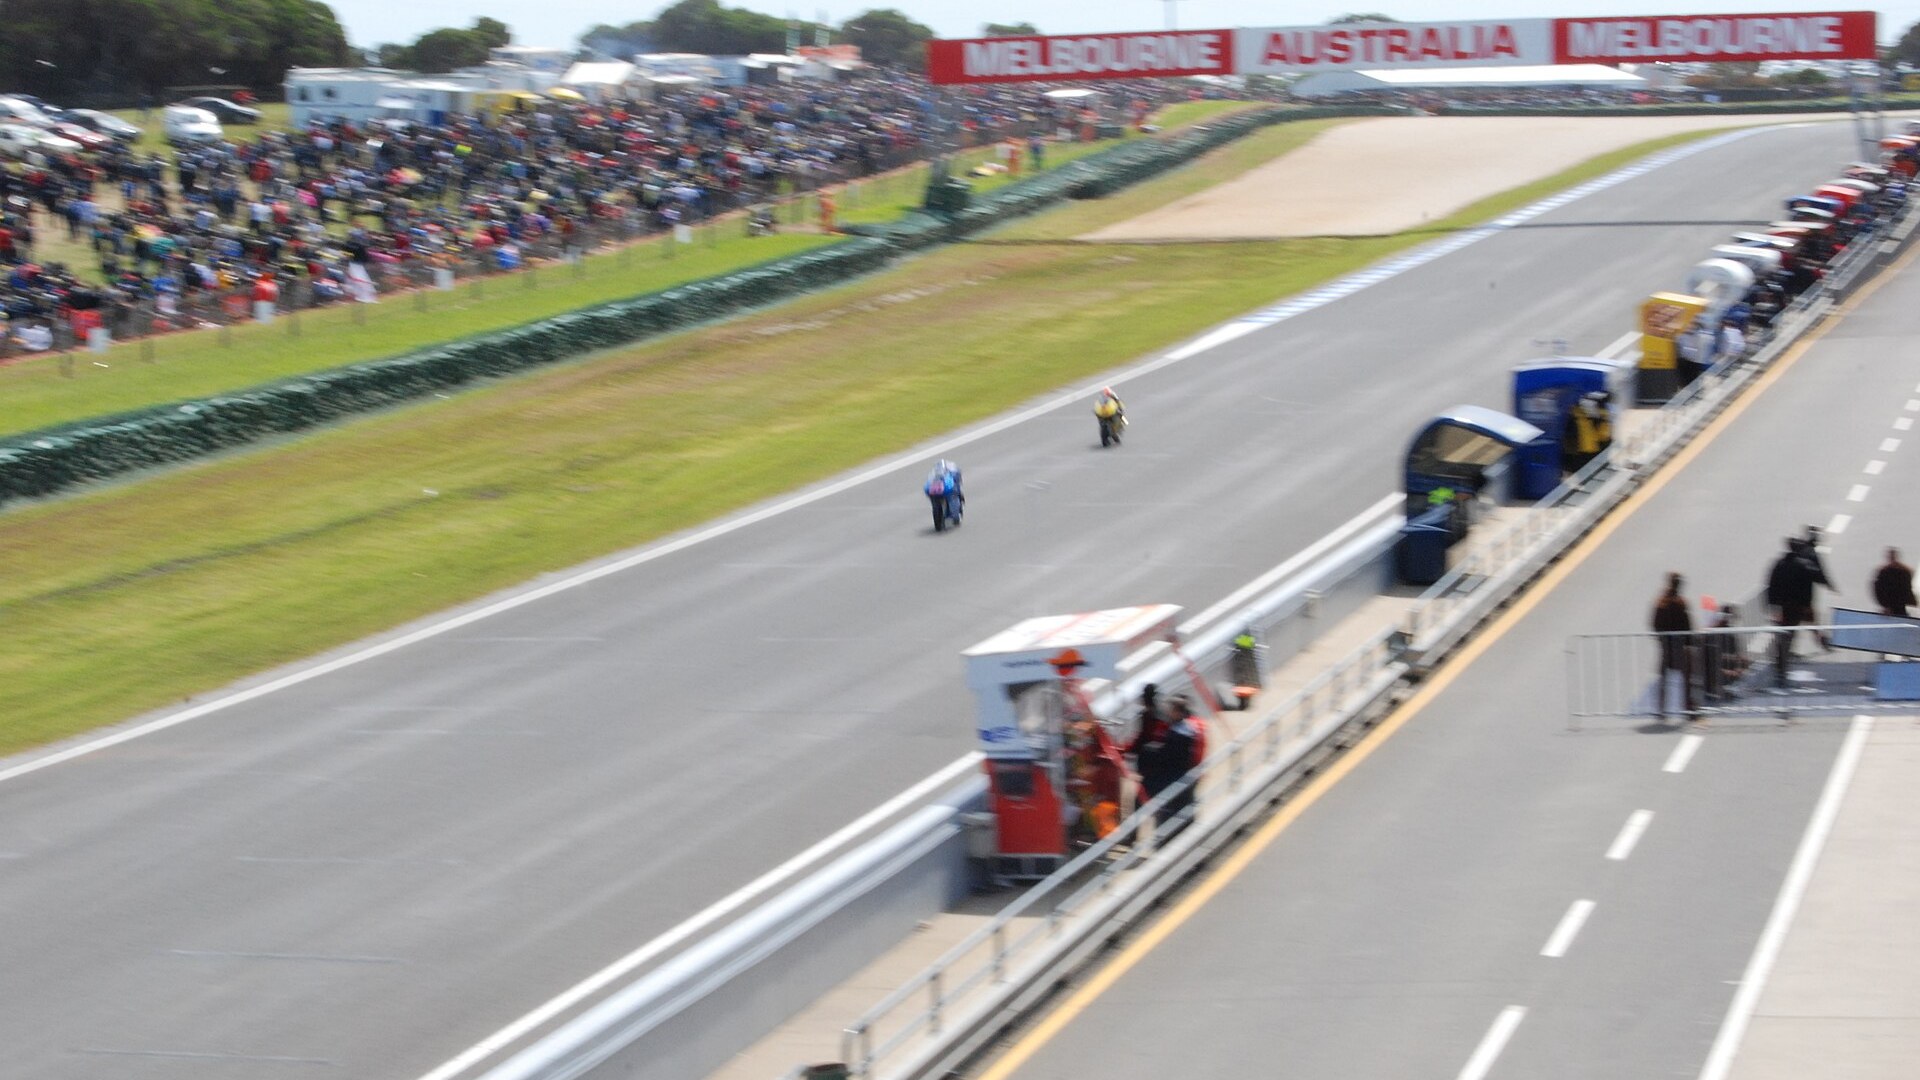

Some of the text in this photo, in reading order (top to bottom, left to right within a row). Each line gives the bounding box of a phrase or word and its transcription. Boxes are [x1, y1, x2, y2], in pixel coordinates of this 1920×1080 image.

[963, 34, 1221, 76] MELBOURNE
[1264, 25, 1518, 65] AUSTRALIA
[1568, 17, 1842, 56] MELBOURNE
